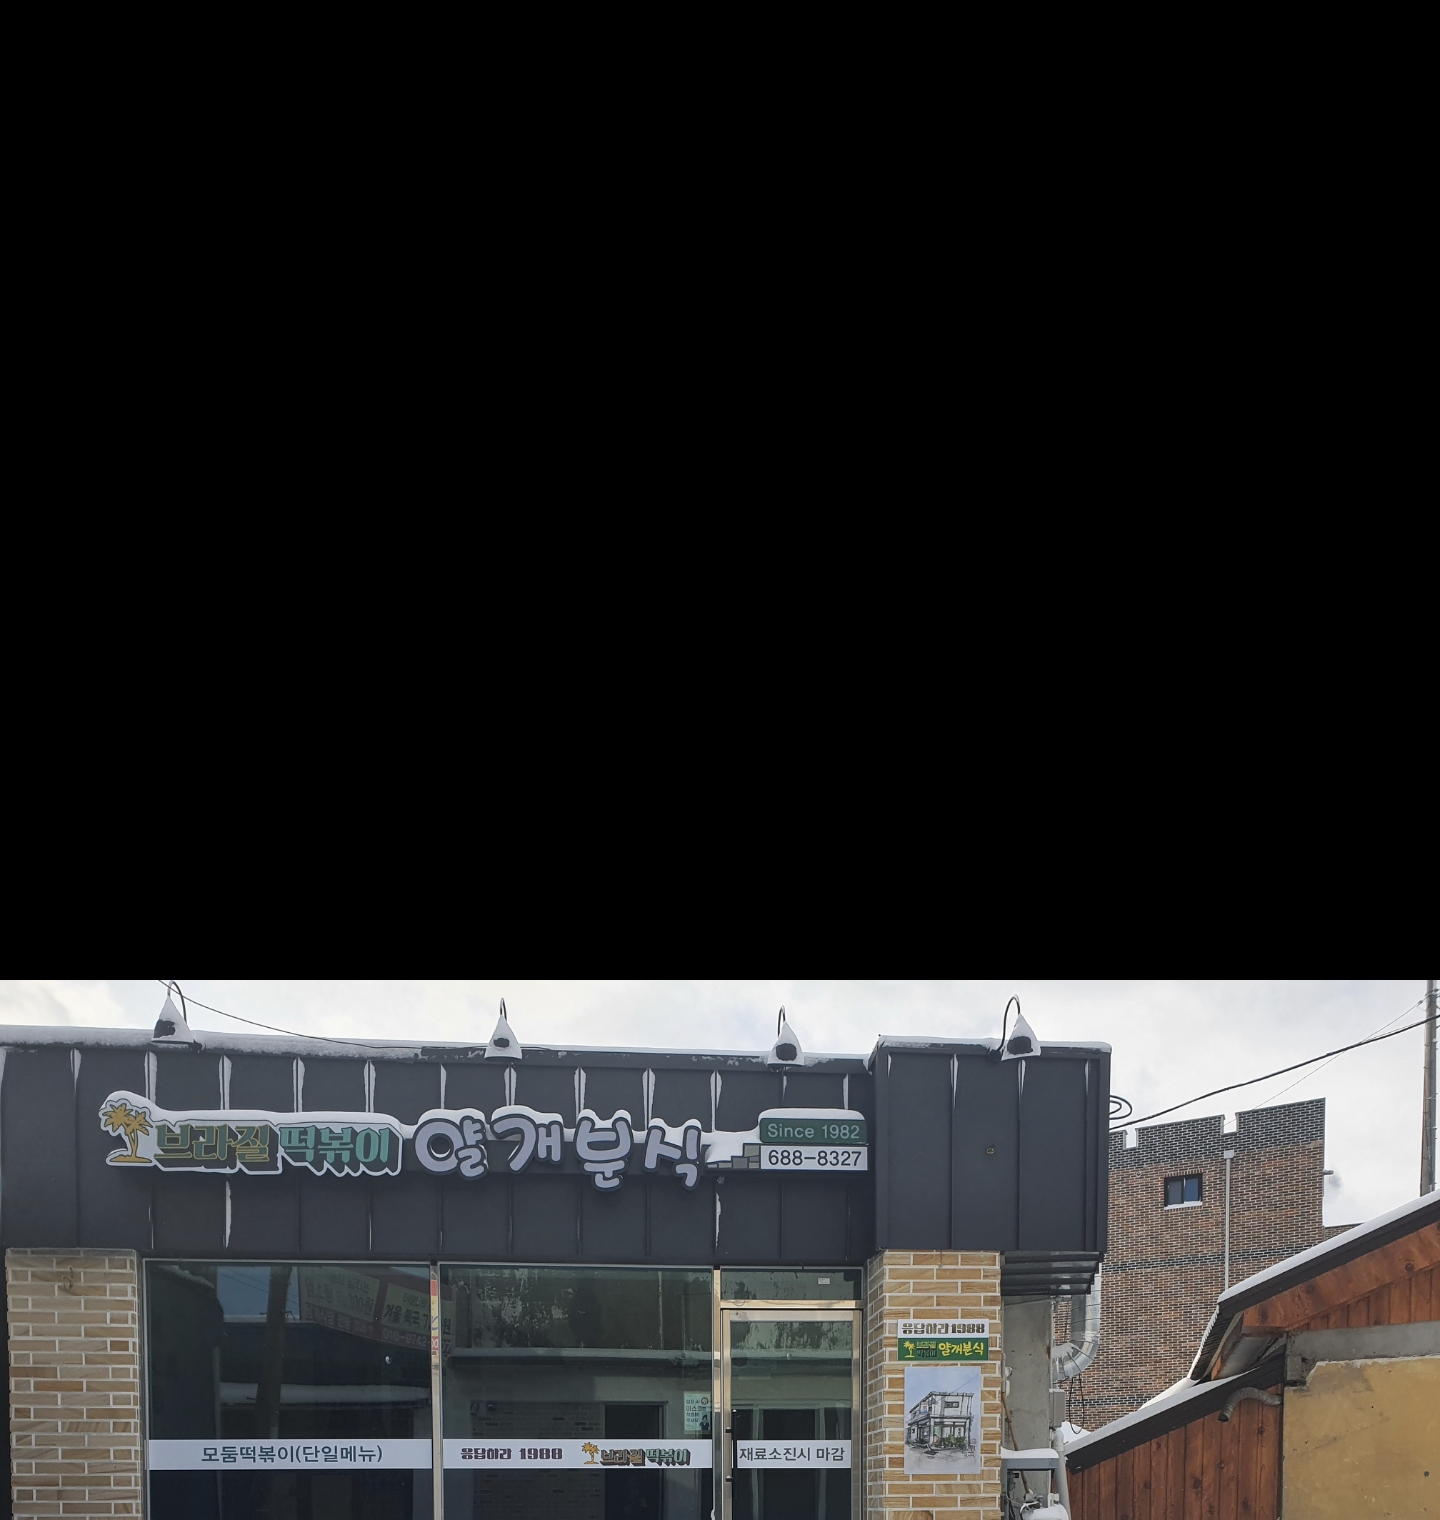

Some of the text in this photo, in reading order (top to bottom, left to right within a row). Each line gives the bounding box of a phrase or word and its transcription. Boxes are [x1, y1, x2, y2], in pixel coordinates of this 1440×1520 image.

[767, 1123, 860, 1139] Since 1982
[154, 1115, 701, 1190] 브라질 떡볶이 얄개분식
[768, 1149, 862, 1167] 688-8327
[901, 1322, 985, 1334] 응답하라 1988
[938, 1341, 984, 1356] 얄개분식
[201, 1445, 383, 1463] 모둠떡볶이(단일메뉴)
[460, 1448, 689, 1465] 응답하라 1988 브라질 떡볶이
[739, 1447, 845, 1461] 재료소진시 마감
